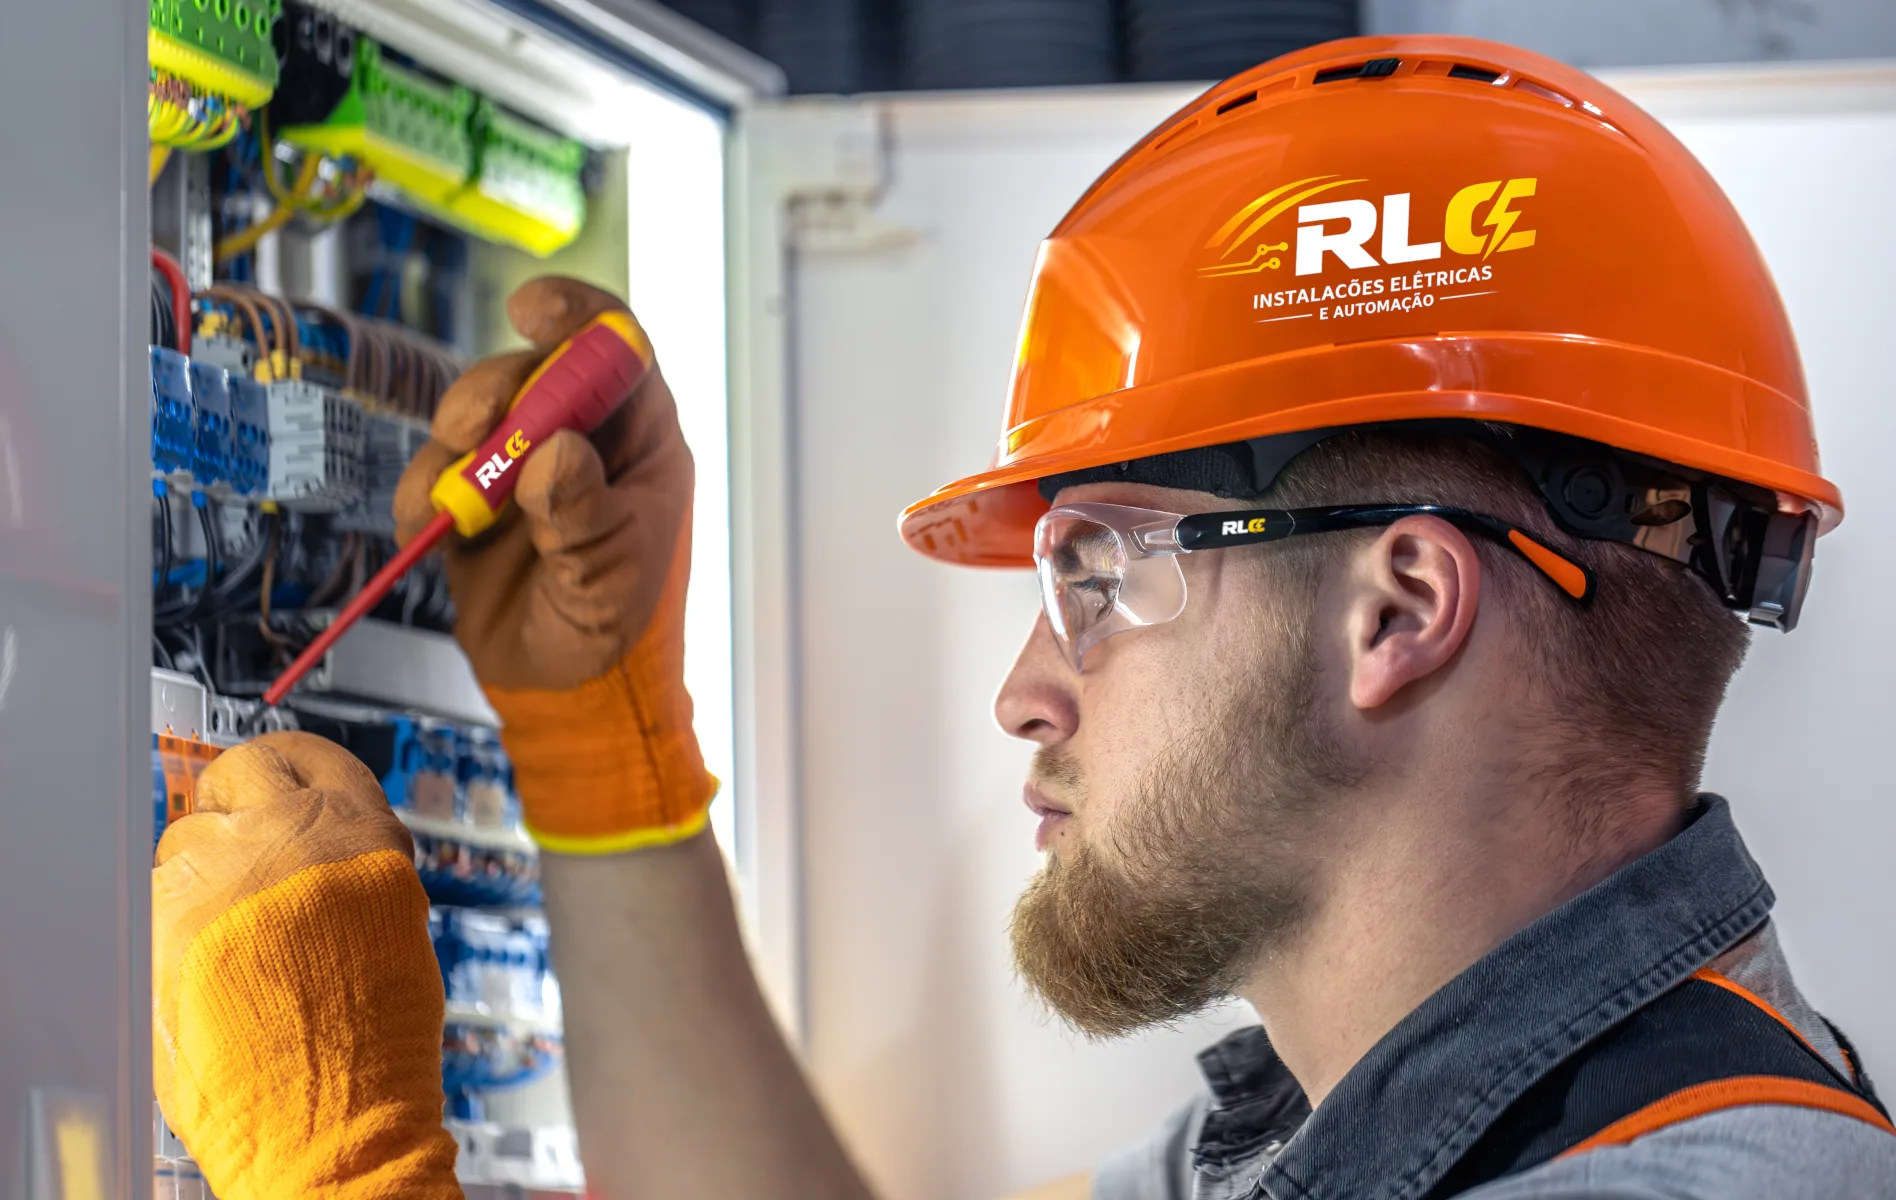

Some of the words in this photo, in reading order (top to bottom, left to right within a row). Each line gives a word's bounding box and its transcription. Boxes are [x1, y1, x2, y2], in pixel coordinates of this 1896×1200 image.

[1390, 265, 1493, 293] ELÊTRICAS
[1319, 307, 1329, 321] E
[1333, 292, 1435, 319] AUTOMAÇÃO
